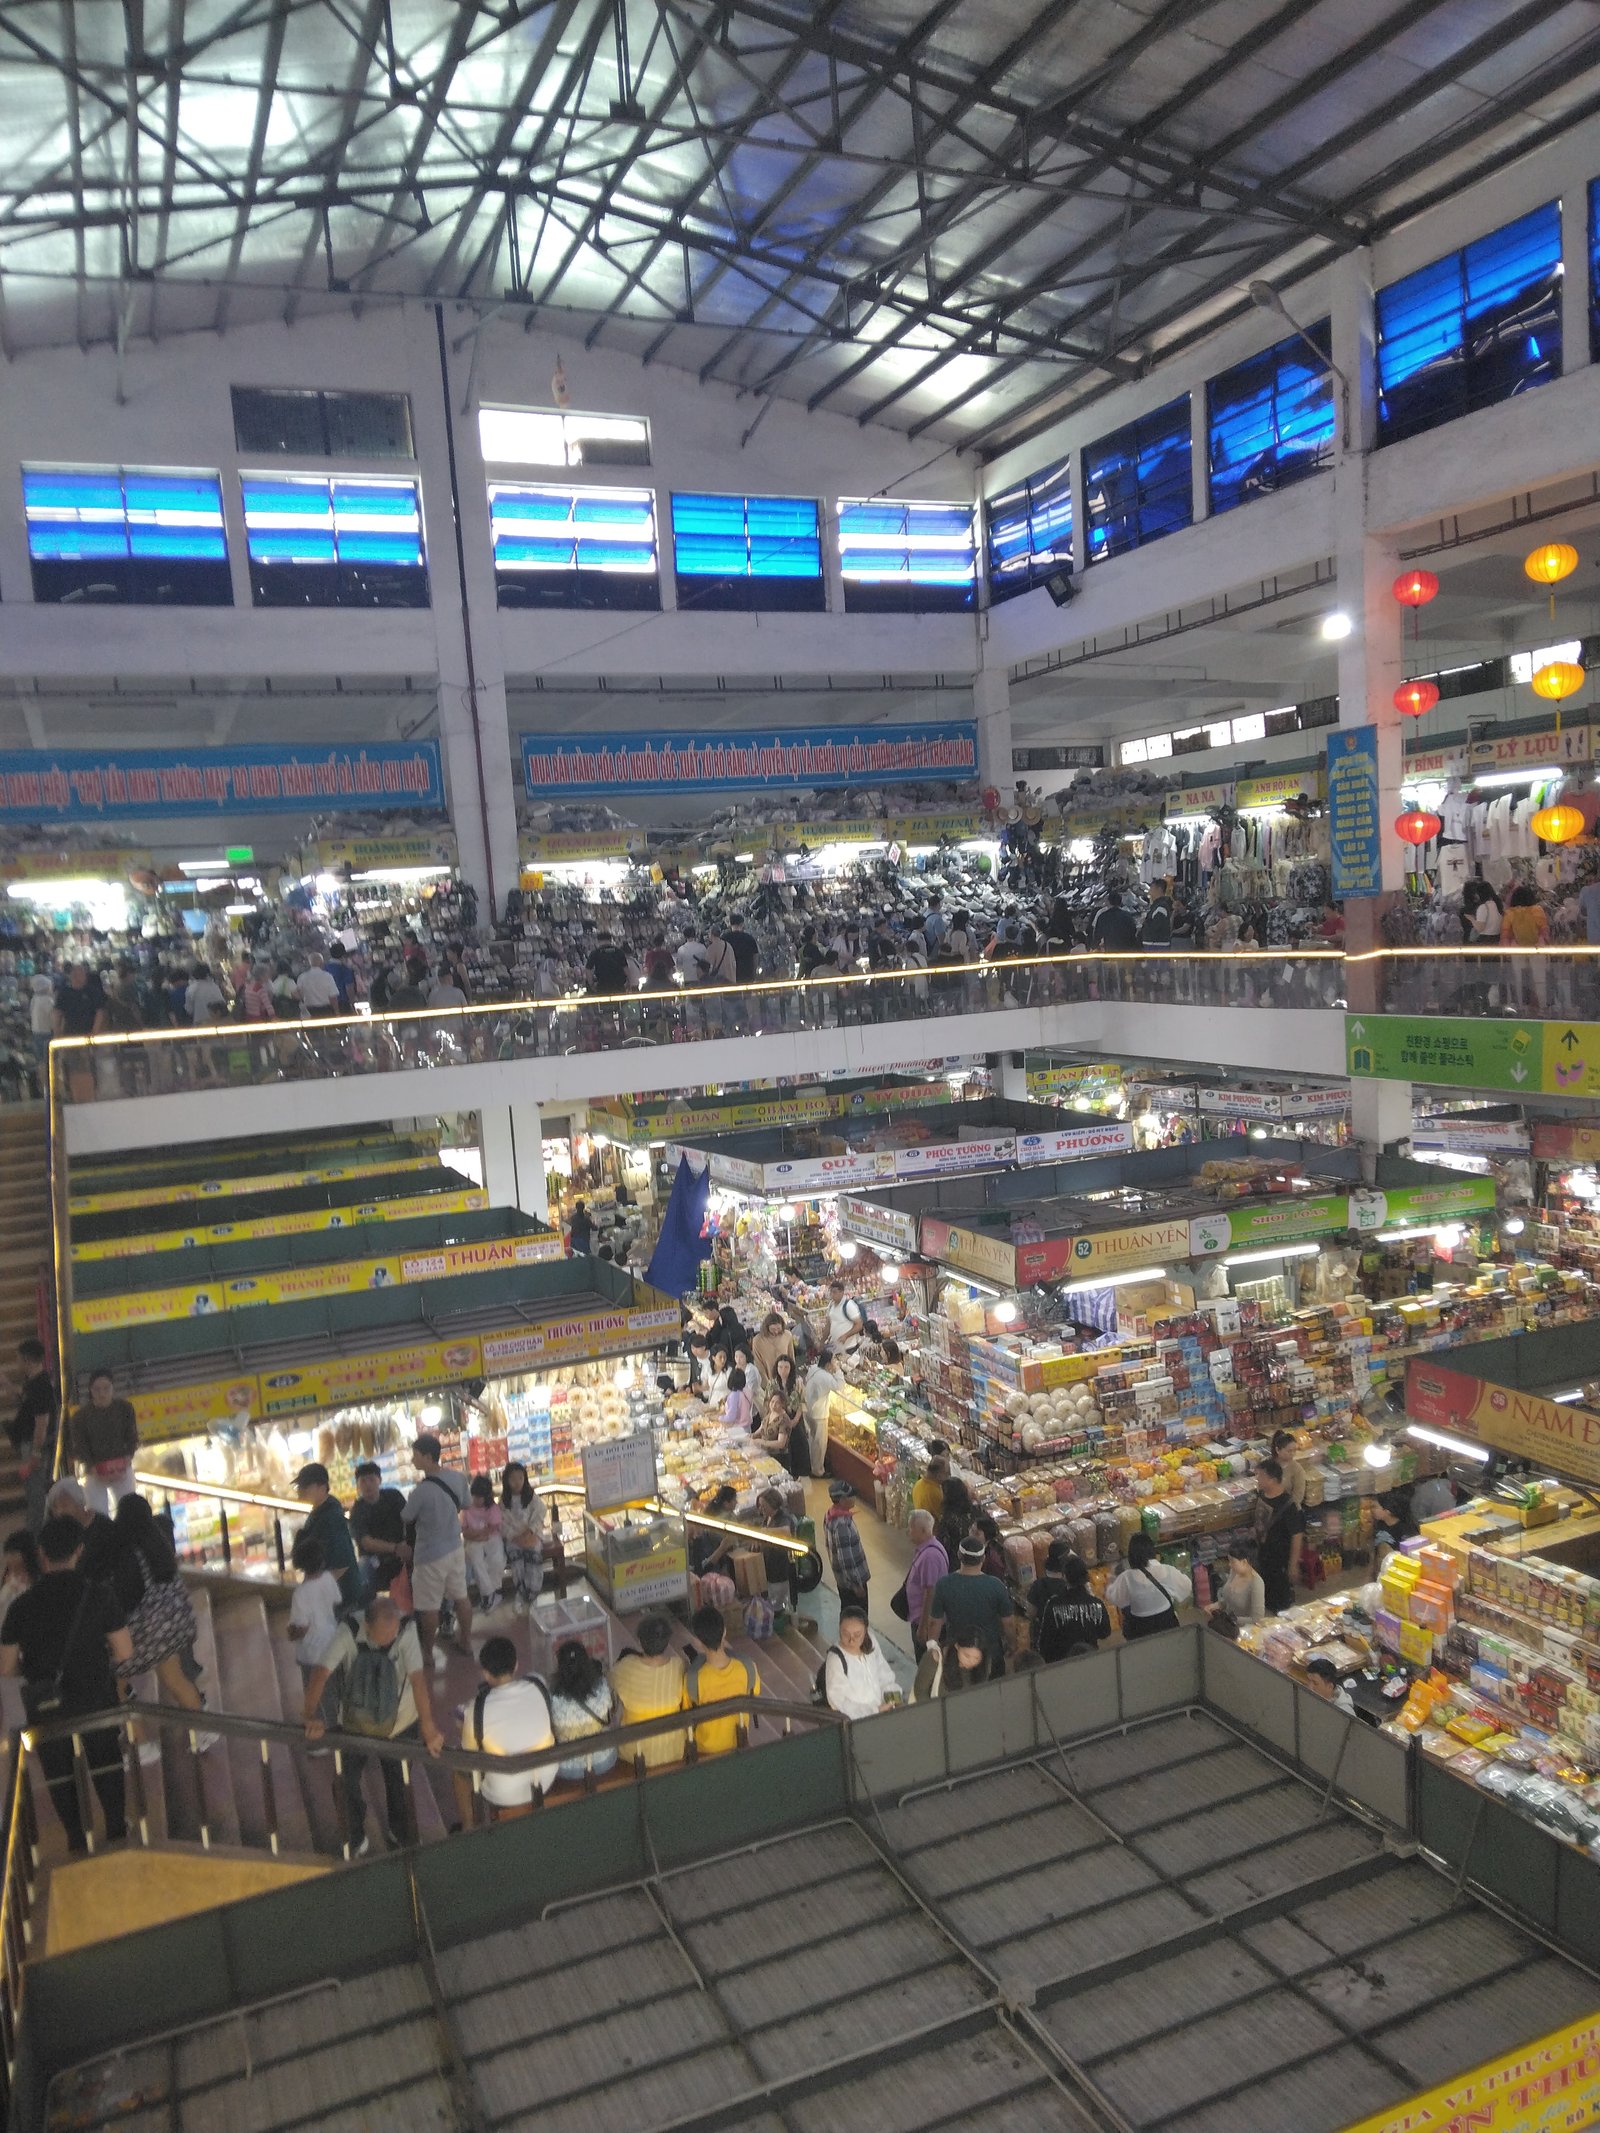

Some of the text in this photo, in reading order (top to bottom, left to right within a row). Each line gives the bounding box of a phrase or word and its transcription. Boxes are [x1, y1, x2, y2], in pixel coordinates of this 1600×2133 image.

[279, 756, 316, 797] THÀNH
[314, 752, 338, 795] PHỐ
[383, 759, 402, 792] GHI
[402, 752, 430, 798] NHẬN
[529, 754, 551, 784] MUA
[551, 746, 571, 784] BÁN
[571, 746, 596, 783] HÀNG
[615, 744, 629, 781] CÓ
[629, 741, 660, 781] NGUỒN
[660, 740, 678, 780] GỐC
[678, 739, 701, 780] XUẤT
[714, 742, 726, 778] RÕ
[725, 741, 749, 777] RÀNG
[760, 736, 787, 783] QUYỀN
[849, 736, 866, 772] CỦA
[448, 1243, 513, 1266] THUẬN
[1077, 1242, 1090, 1255] 52
[1094, 1232, 1152, 1255] THUẬN
[1512, 1396, 1574, 1439] NAM
